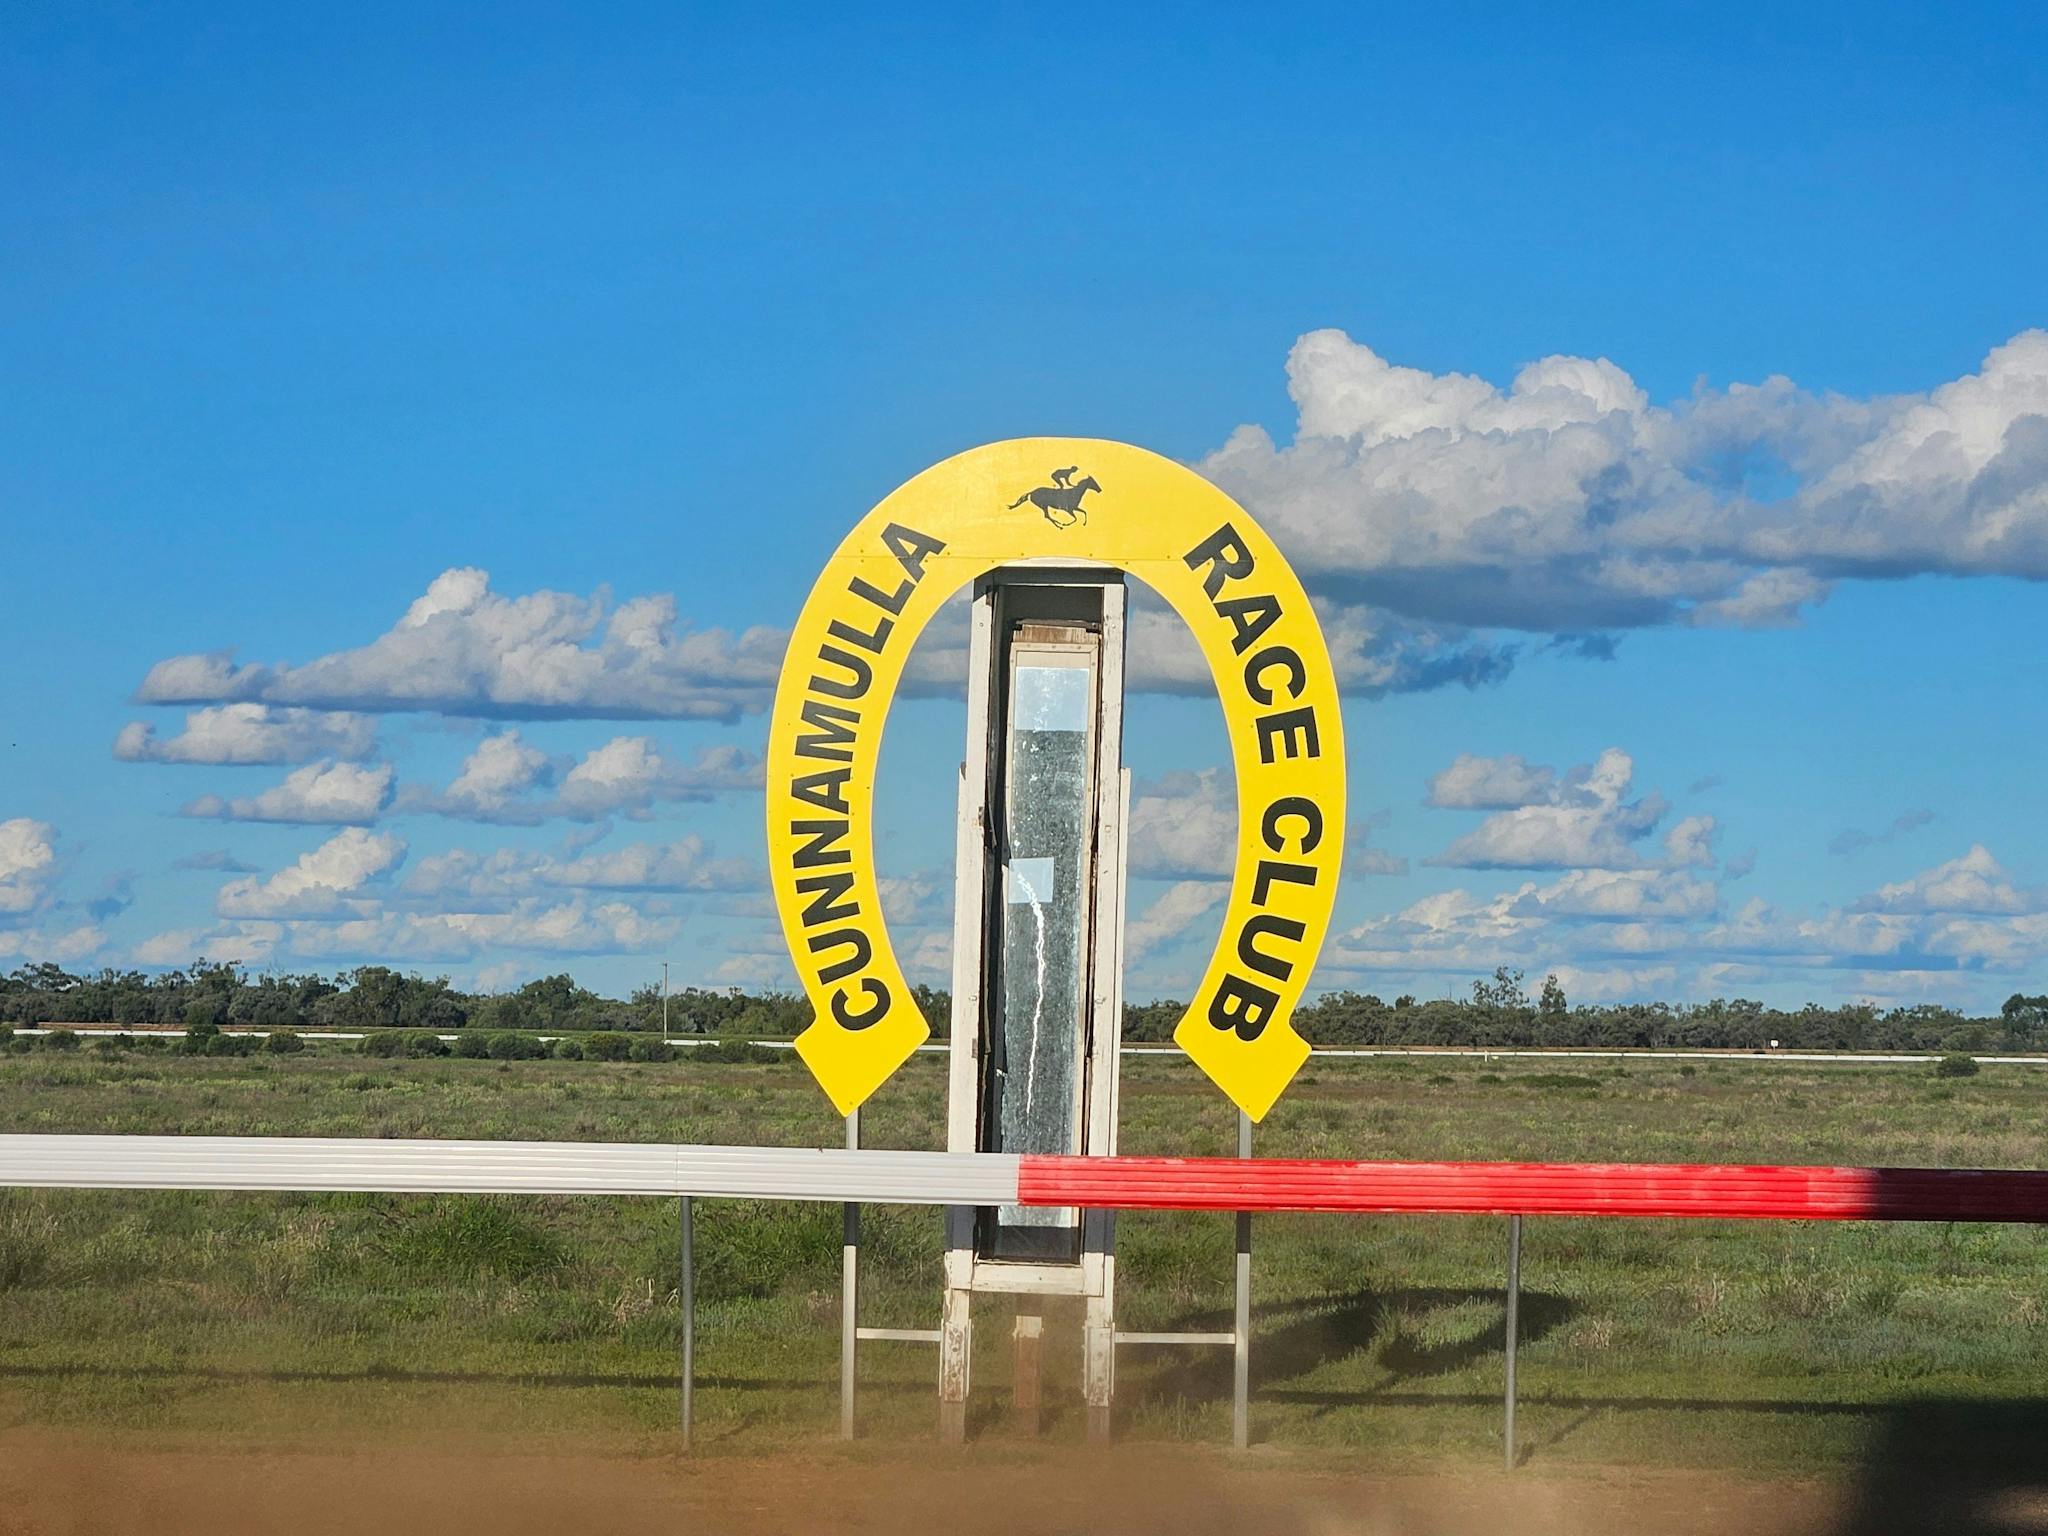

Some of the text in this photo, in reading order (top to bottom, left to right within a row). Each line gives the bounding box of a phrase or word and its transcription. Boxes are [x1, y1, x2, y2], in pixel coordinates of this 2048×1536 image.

[791, 523, 948, 1031] CUNNAMULLA
[1183, 522, 1323, 1042] RACE CLUB
